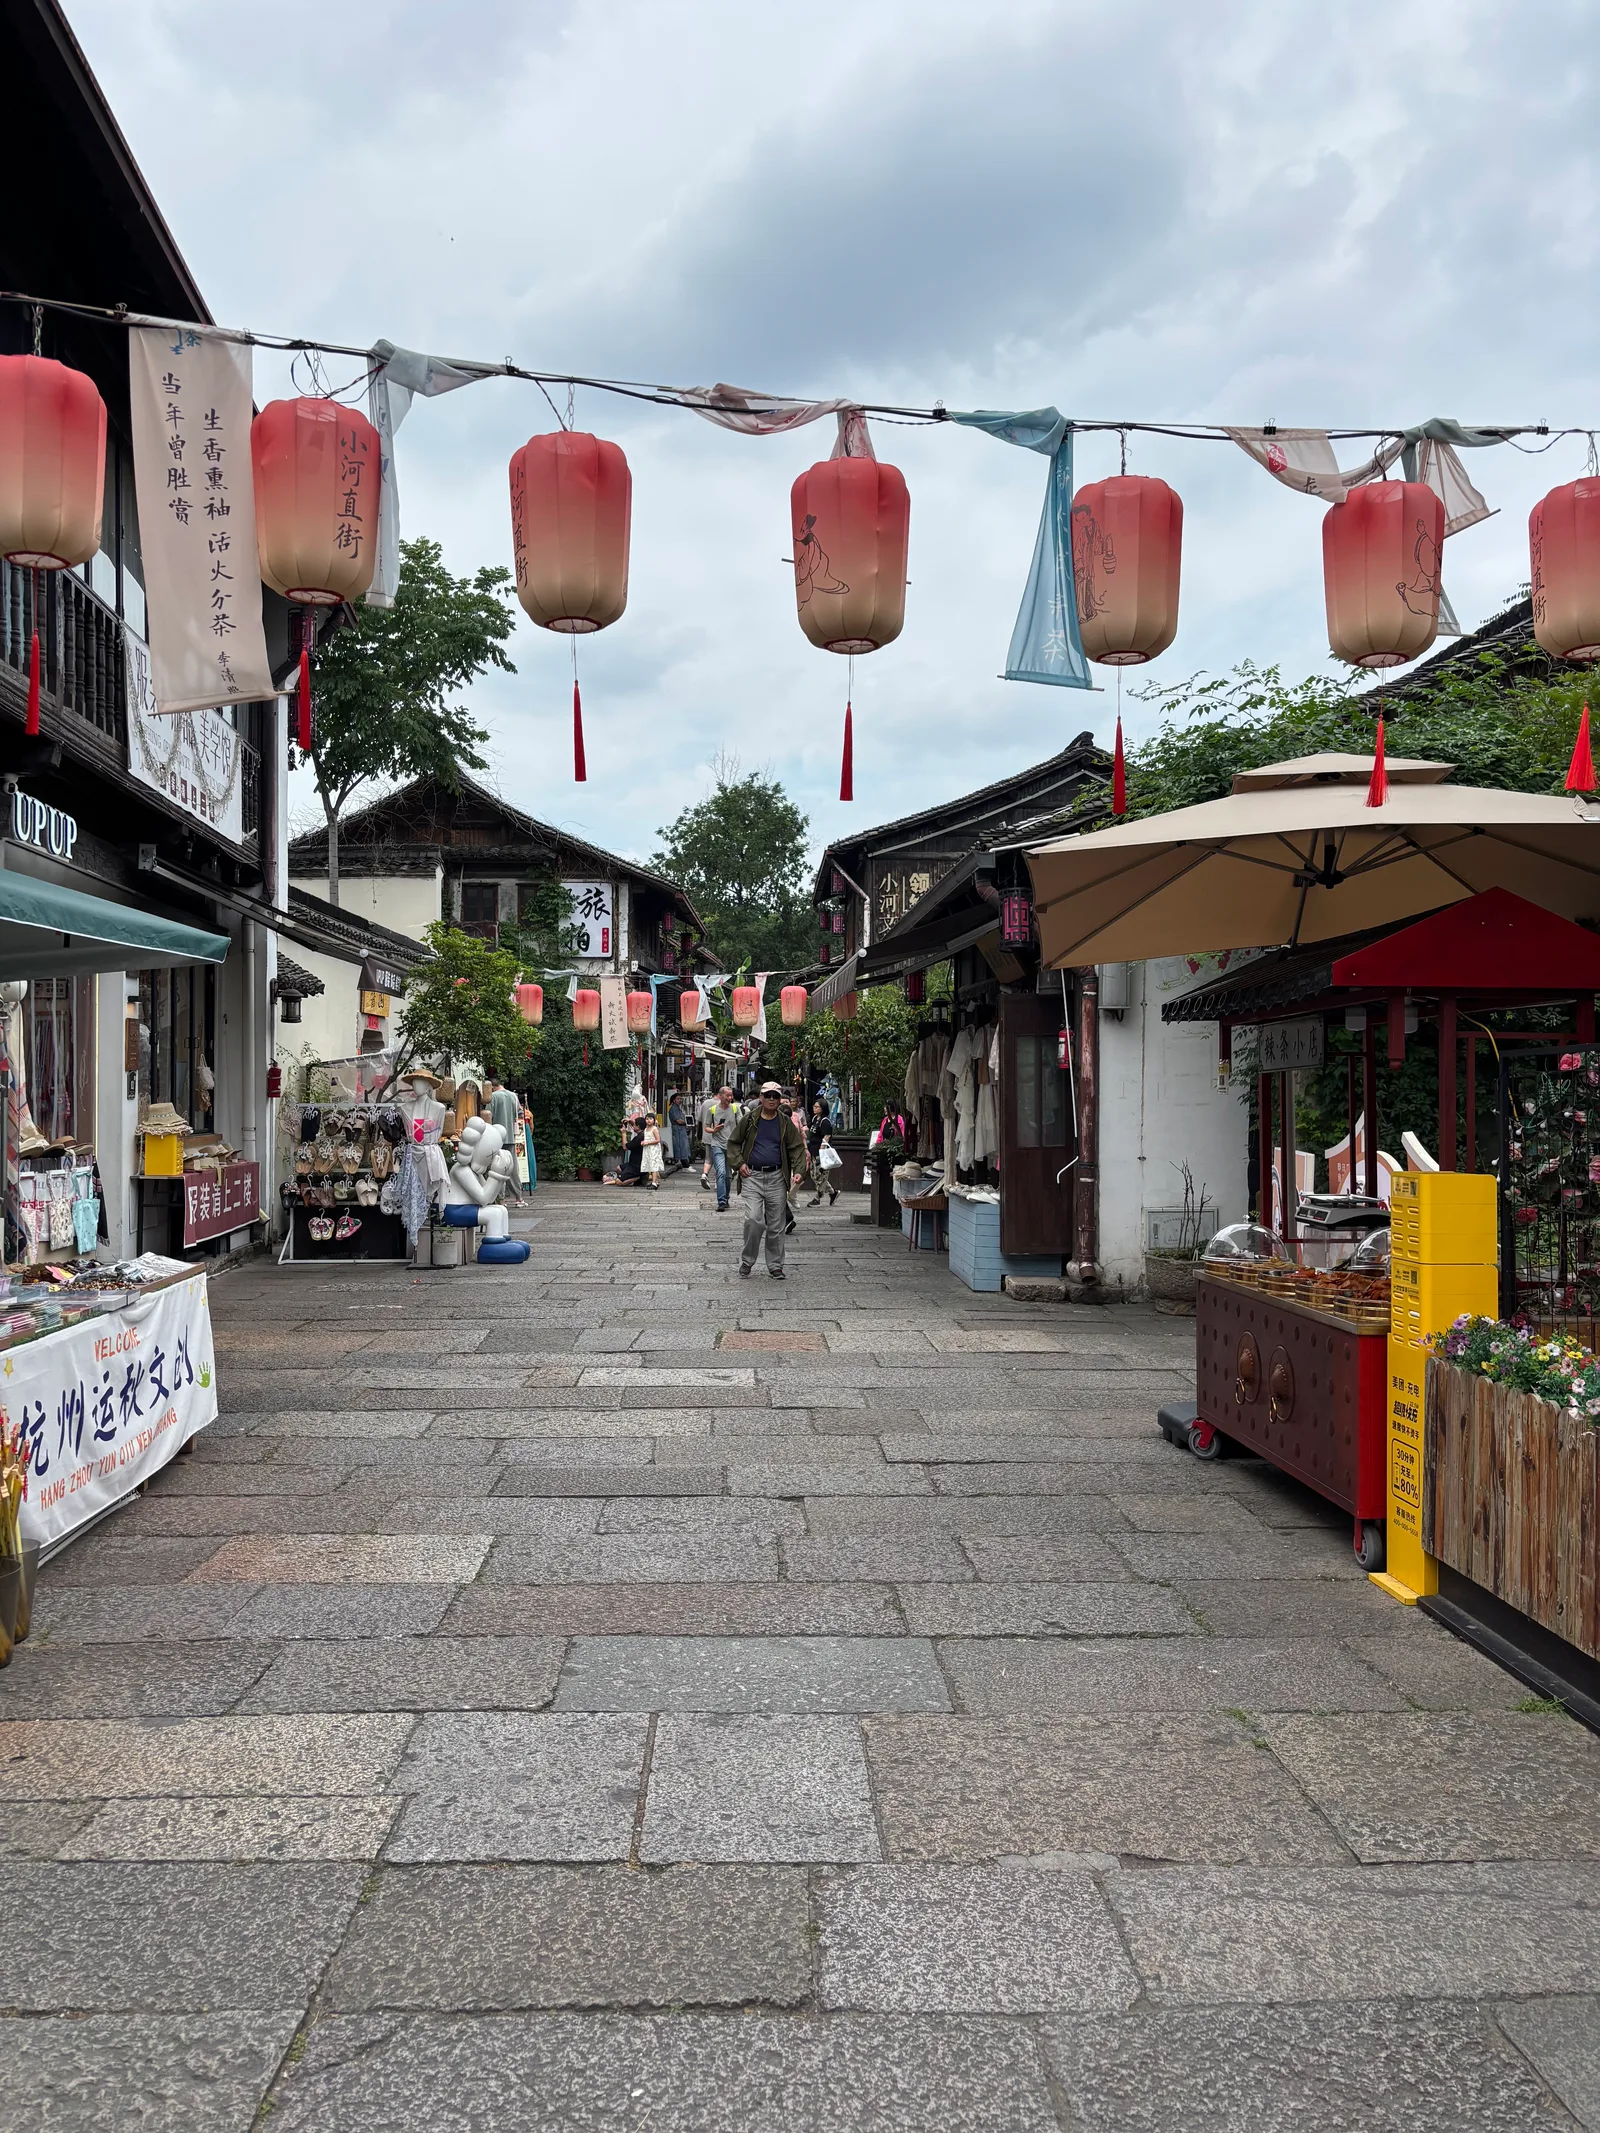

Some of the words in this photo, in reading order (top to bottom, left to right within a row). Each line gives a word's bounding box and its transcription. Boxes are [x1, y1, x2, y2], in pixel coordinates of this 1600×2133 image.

[161, 372, 194, 526] 当年曾胜赏
[332, 430, 368, 560] 小河直街
[510, 466, 529, 589] 小河直街
[1531, 515, 1547, 625] 小河直街
[13, 790, 78, 860] UPUP
[1264, 1024, 1319, 1064] 辣条小店
[94, 1326, 141, 1363] WELCOME
[18, 1324, 194, 1477] 杭州运秋文创
[40, 1477, 66, 1512] HANG
[69, 1461, 95, 1494] ZHOU
[98, 1450, 117, 1478] YUN
[119, 1439, 135, 1467] QIU
[136, 1427, 153, 1456] WEN
[1396, 1448, 1415, 1467] 30分钟
[1400, 1478, 1419, 1501] 80%
